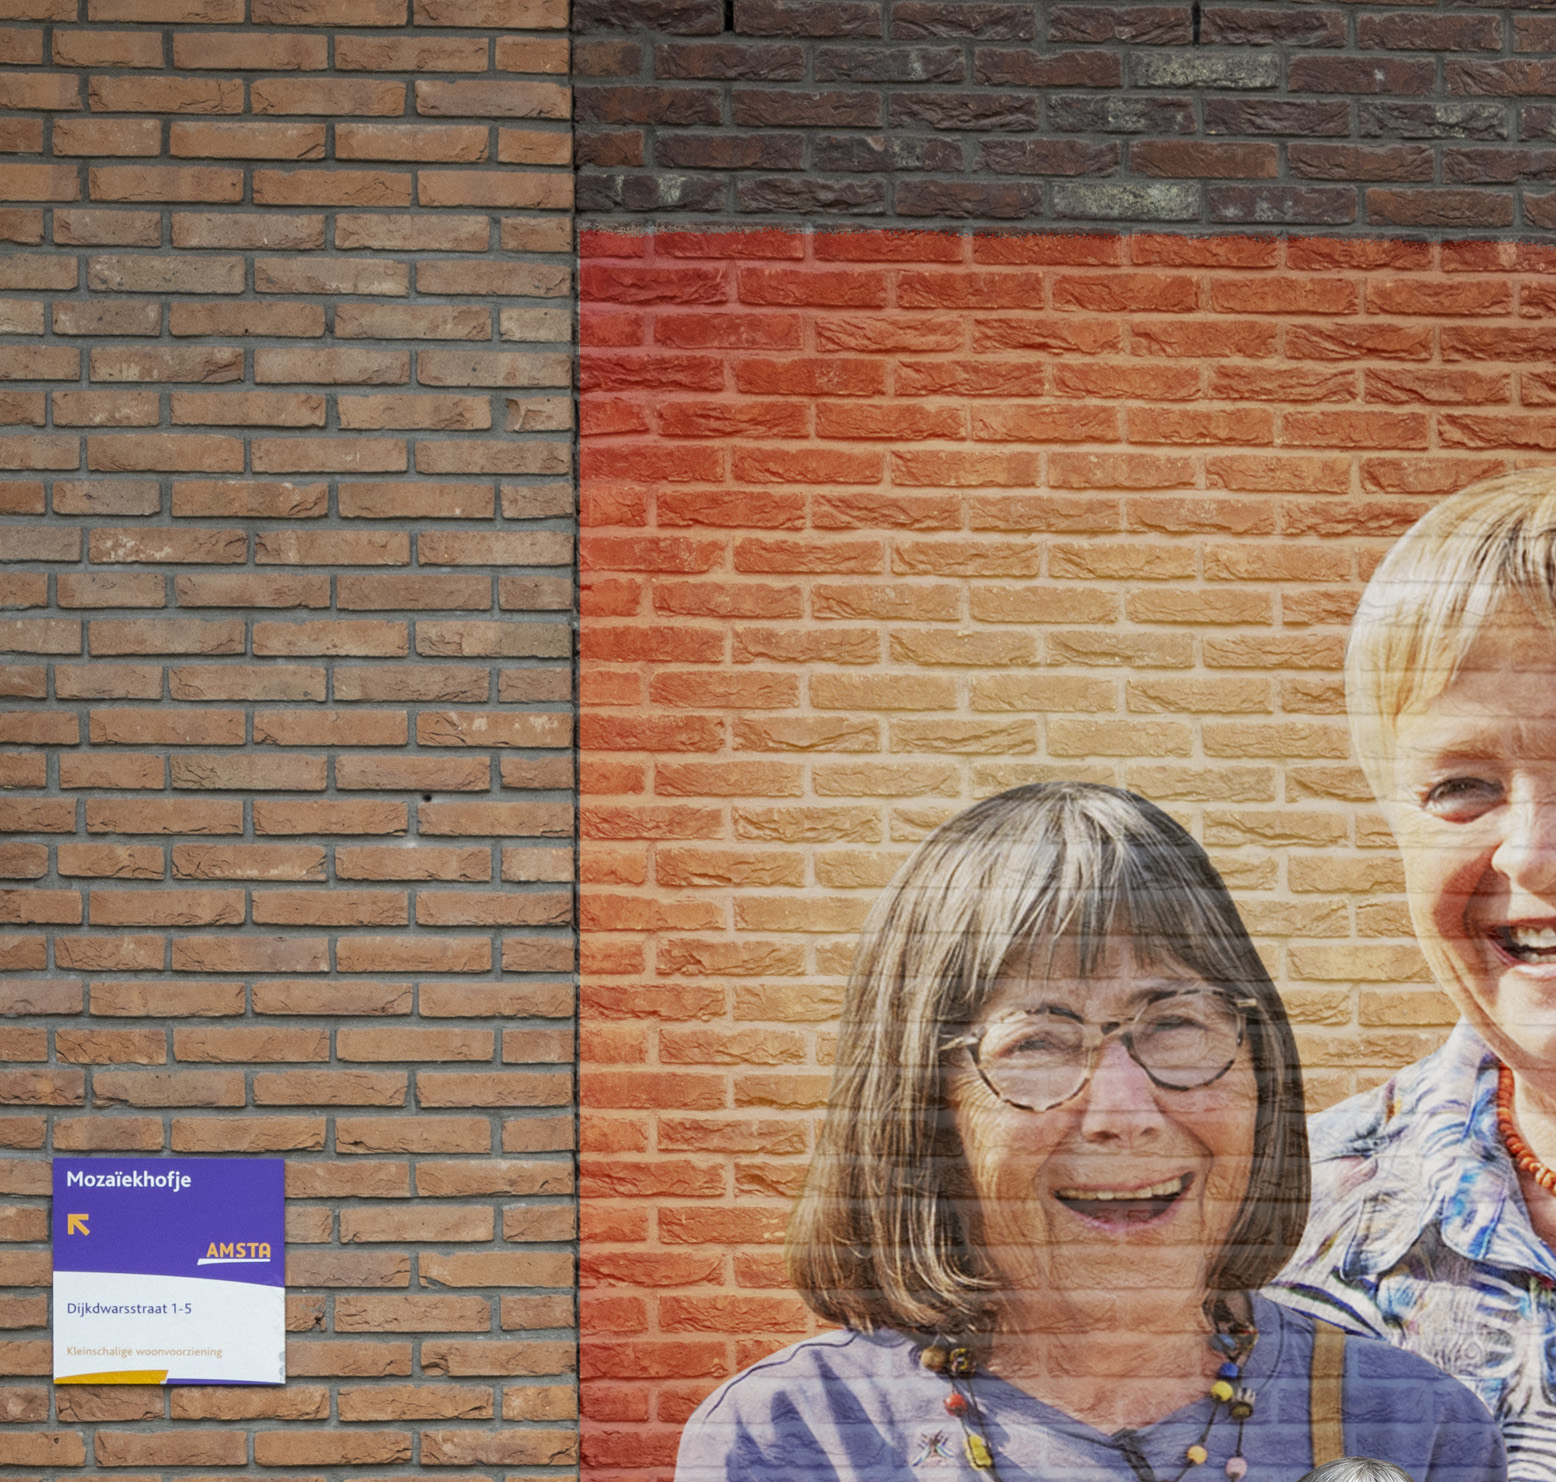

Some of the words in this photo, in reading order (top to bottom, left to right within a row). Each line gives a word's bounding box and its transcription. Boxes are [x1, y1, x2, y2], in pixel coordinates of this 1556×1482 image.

[66, 1170, 192, 1192] Mozaïekhofje
[206, 1242, 271, 1258] AMSTA
[66, 1303, 168, 1317] Dijkdwarsstraat
[171, 1303, 192, 1314] 1-5
[66, 1346, 133, 1358] Kleinschalige
[136, 1347, 223, 1359] woonvoorziening
